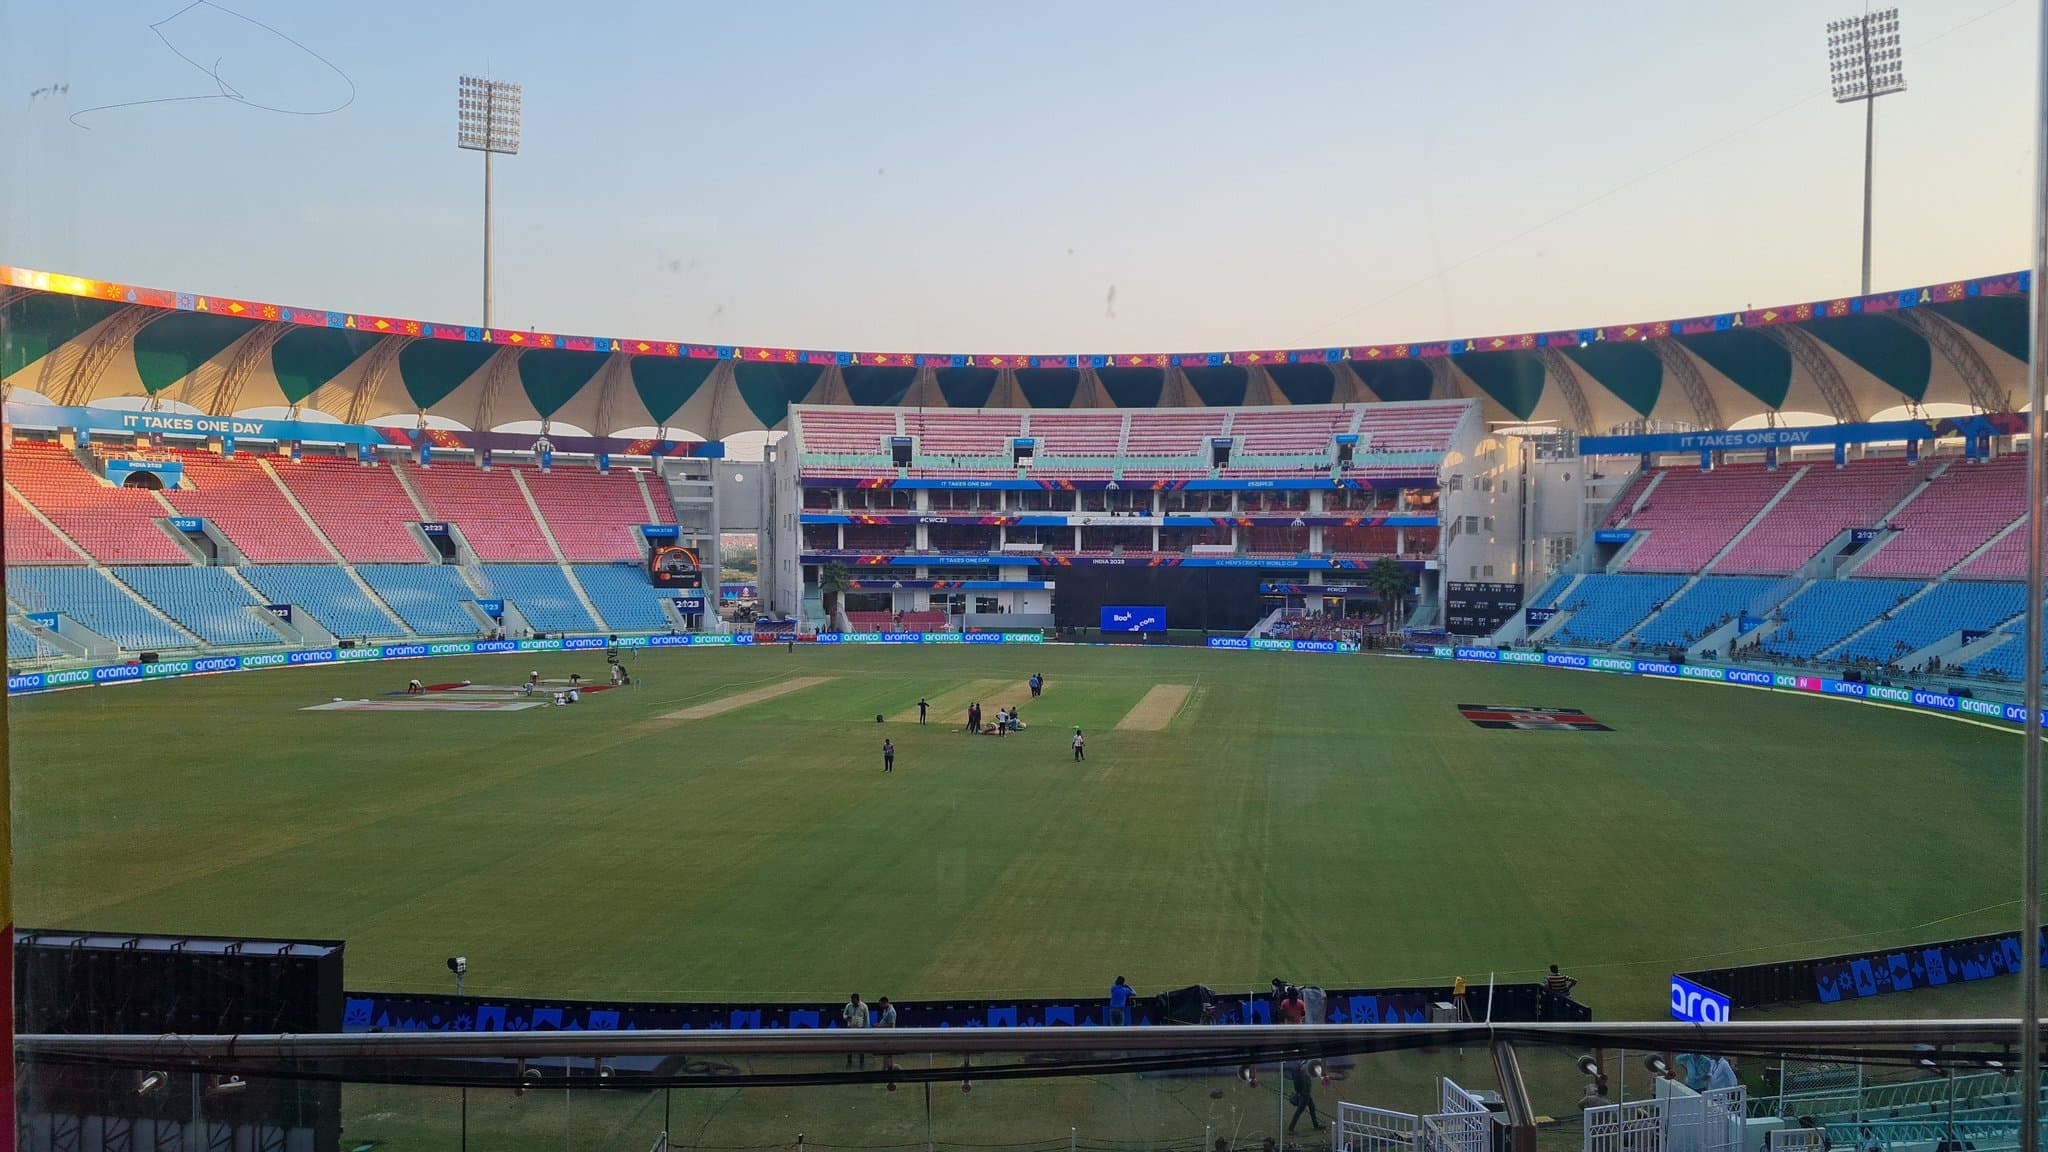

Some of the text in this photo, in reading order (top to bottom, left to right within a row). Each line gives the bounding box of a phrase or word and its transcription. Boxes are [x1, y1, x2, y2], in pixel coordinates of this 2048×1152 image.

[124, 415, 264, 434] IT TAKES ONE DAY
[1681, 431, 1810, 447] IT TAKES ONE DAY
[675, 600, 699, 608] 2023
[1113, 611, 1132, 622] Book
[844, 632, 879, 641] aramco
[885, 632, 919, 641] aramco
[925, 633, 960, 641] aramco
[965, 633, 1000, 641] aramco
[1005, 633, 1040, 642] aramco
[1211, 637, 1248, 647] aramco
[1254, 639, 1291, 649] aramco
[1297, 641, 1334, 650] aramco
[9, 676, 40, 688] amco
[47, 669, 89, 684] aramco
[96, 665, 139, 678] aramco
[145, 661, 188, 674] aramco
[195, 657, 236, 670] aramco
[243, 653, 284, 666] aramco
[291, 650, 333, 662] aramco
[339, 648, 379, 660] aramco
[386, 645, 425, 656] aramco
[431, 642, 470, 653] aramco
[477, 640, 515, 651] aramco
[522, 638, 560, 649] aramco
[566, 637, 603, 647] aramco
[652, 634, 689, 644] aramco
[695, 633, 731, 643] aramco
[1459, 648, 1496, 659] aramco
[1503, 651, 1541, 662] aramco
[1547, 655, 1586, 666] aramco
[1593, 658, 1632, 670] aramco
[1638, 662, 1677, 674] aramco
[1683, 666, 1722, 678] aramco
[1728, 671, 1770, 683] aramco
[1870, 687, 1909, 701] aramco
[1915, 692, 1955, 708] aramco
[1962, 699, 2001, 716] aramco
